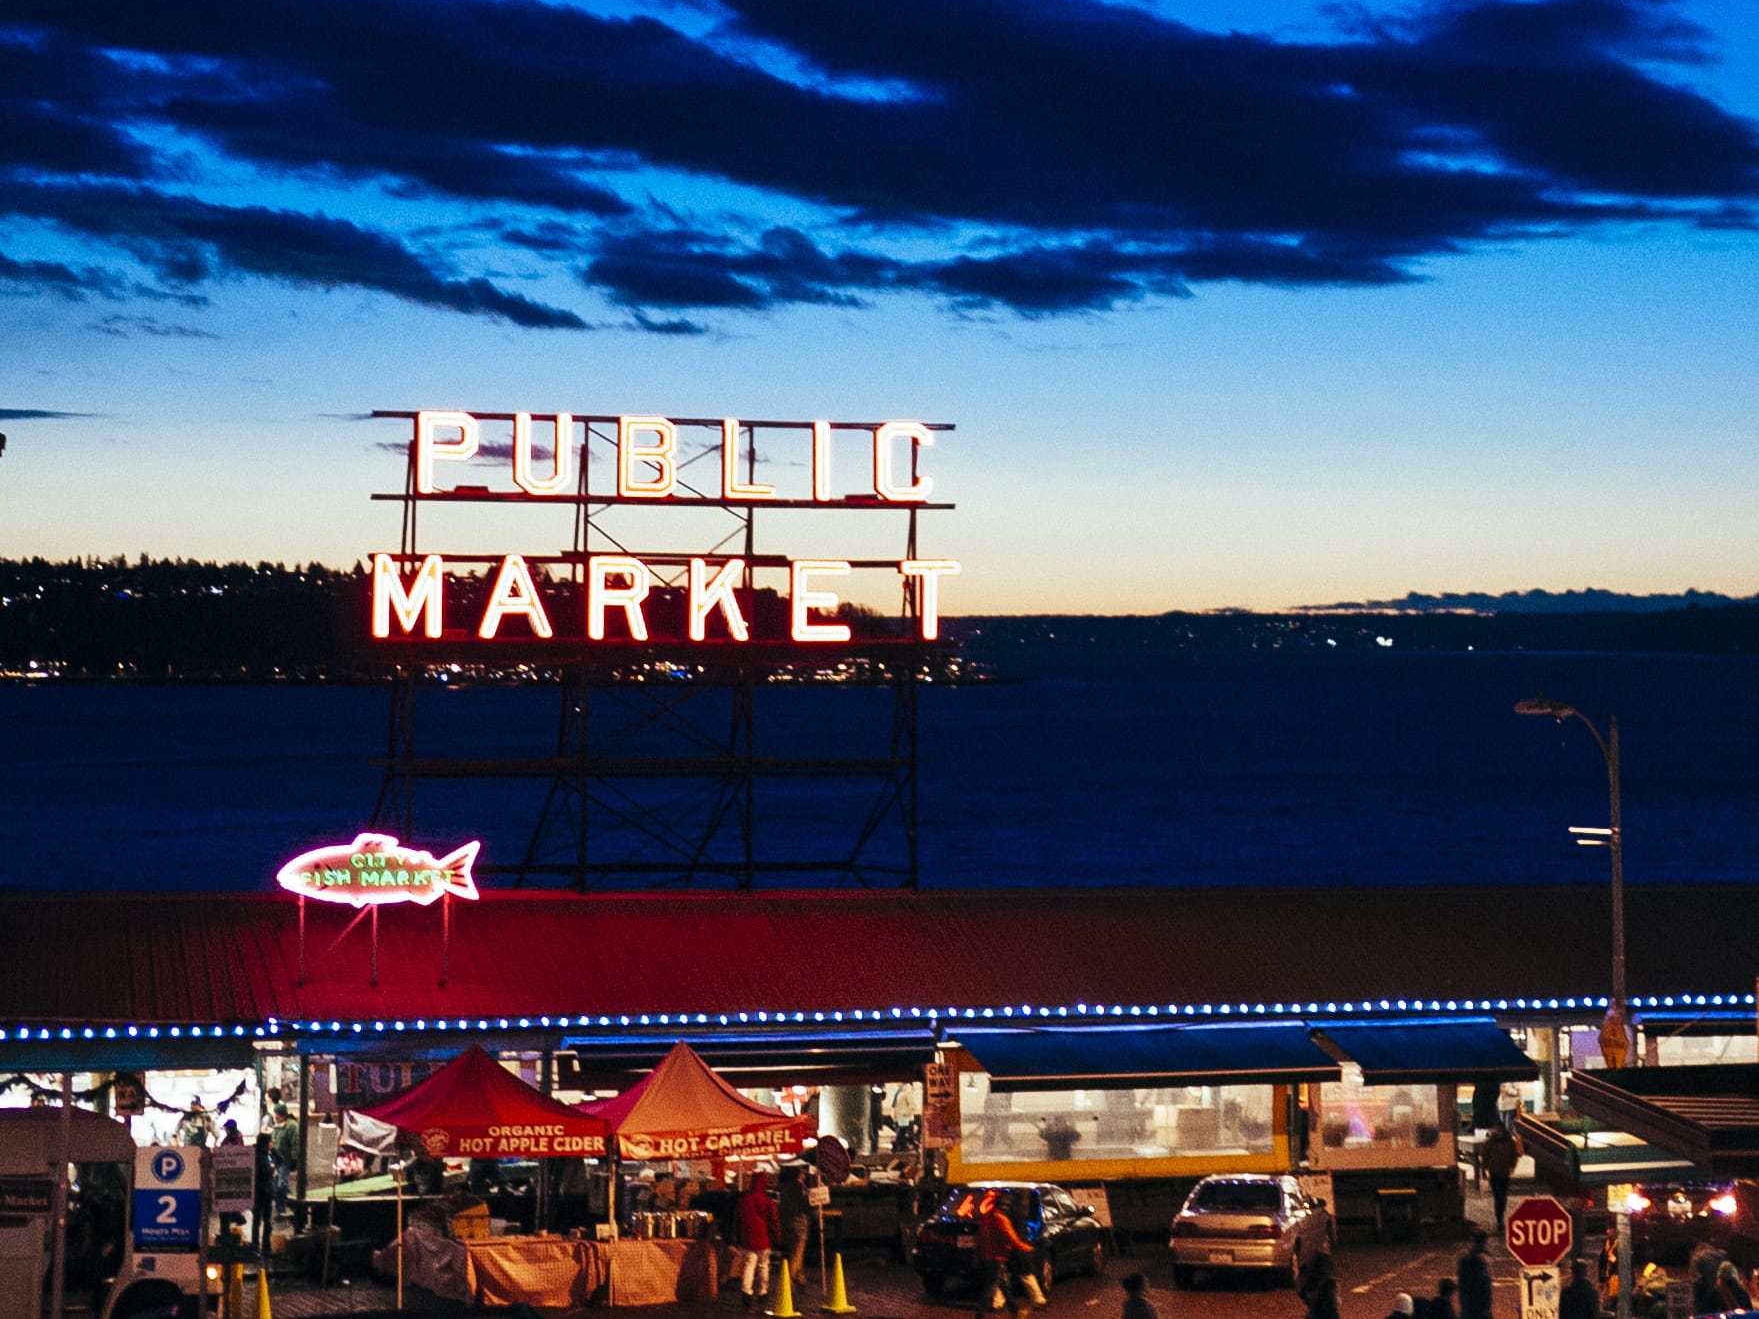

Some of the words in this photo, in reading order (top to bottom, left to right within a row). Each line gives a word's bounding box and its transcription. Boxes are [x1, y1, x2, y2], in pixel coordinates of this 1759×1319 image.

[415, 410, 935, 502] PUBLIC
[371, 553, 961, 642] MARKET
[350, 851, 405, 869] CITY
[300, 869, 351, 887] FISH
[360, 869, 455, 887] MARKET
[929, 1065, 952, 1077] ONE
[929, 1077, 953, 1088] WAY
[488, 1125, 565, 1138] ORGANIC
[658, 1136, 700, 1155] HOT
[705, 1127, 797, 1151] CARAMEL
[459, 1137, 494, 1153] HOT
[496, 1137, 549, 1153] APPLE
[553, 1136, 606, 1152] CIDER
[161, 1157, 177, 1177] P
[156, 1195, 177, 1223] 2
[1511, 1219, 1567, 1246] STOP
